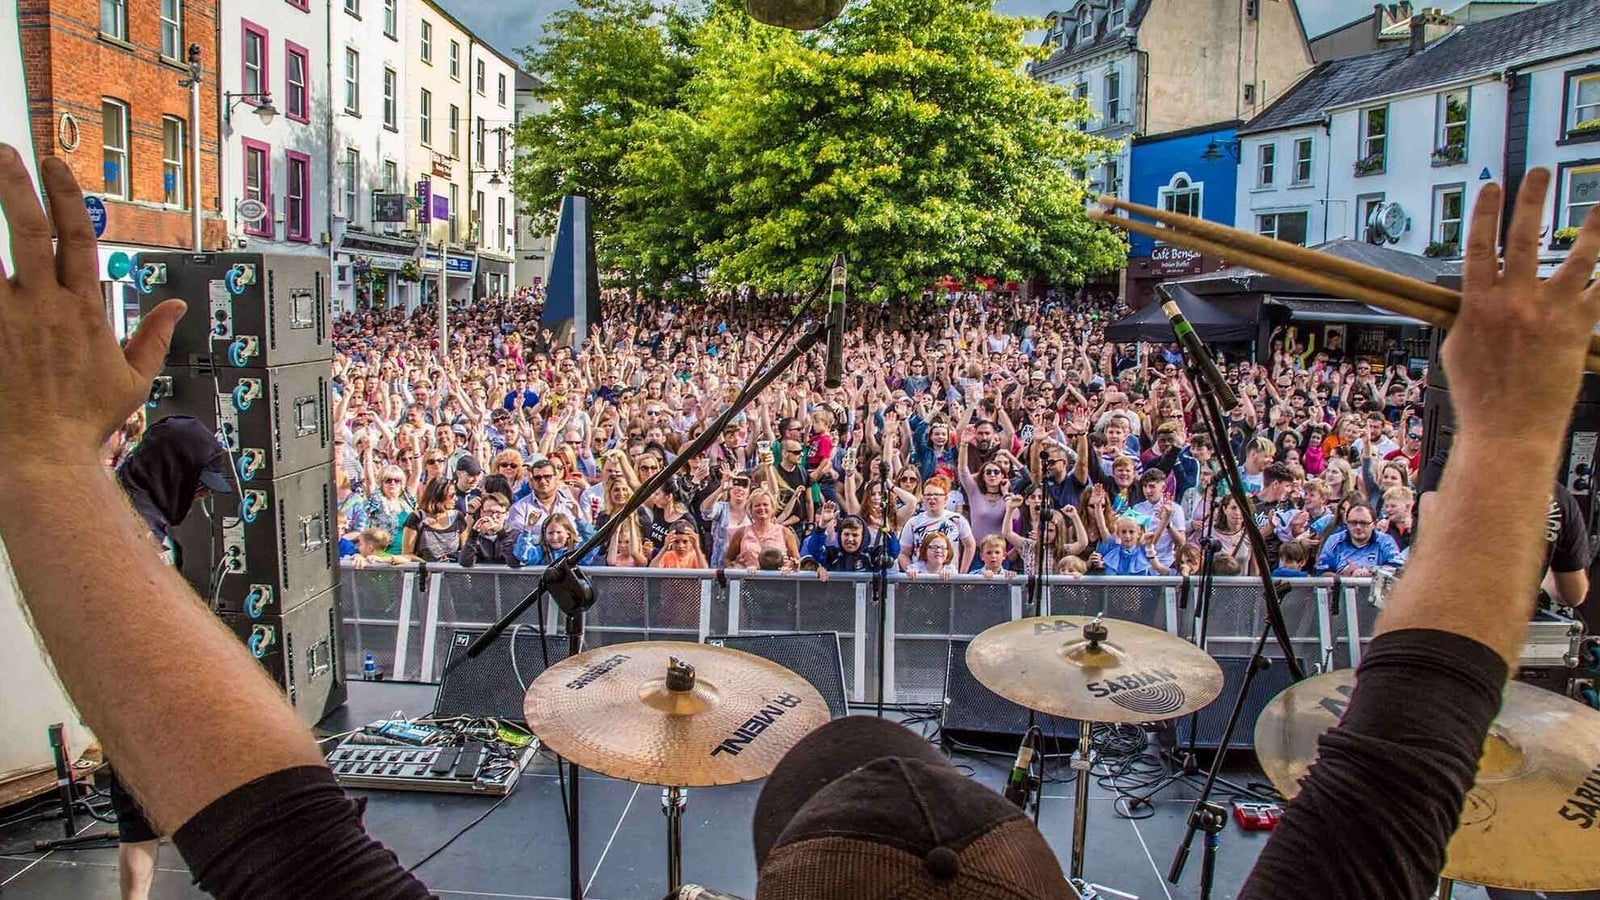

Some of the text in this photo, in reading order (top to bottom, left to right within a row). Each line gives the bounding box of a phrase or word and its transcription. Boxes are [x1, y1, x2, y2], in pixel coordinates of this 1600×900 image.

[1151, 247, 1170, 260] Café
[651, 522, 669, 536] CALL
[1086, 668, 1178, 698] SABIAN
[710, 704, 785, 756] MEINL
[1558, 764, 1600, 829] SABI
